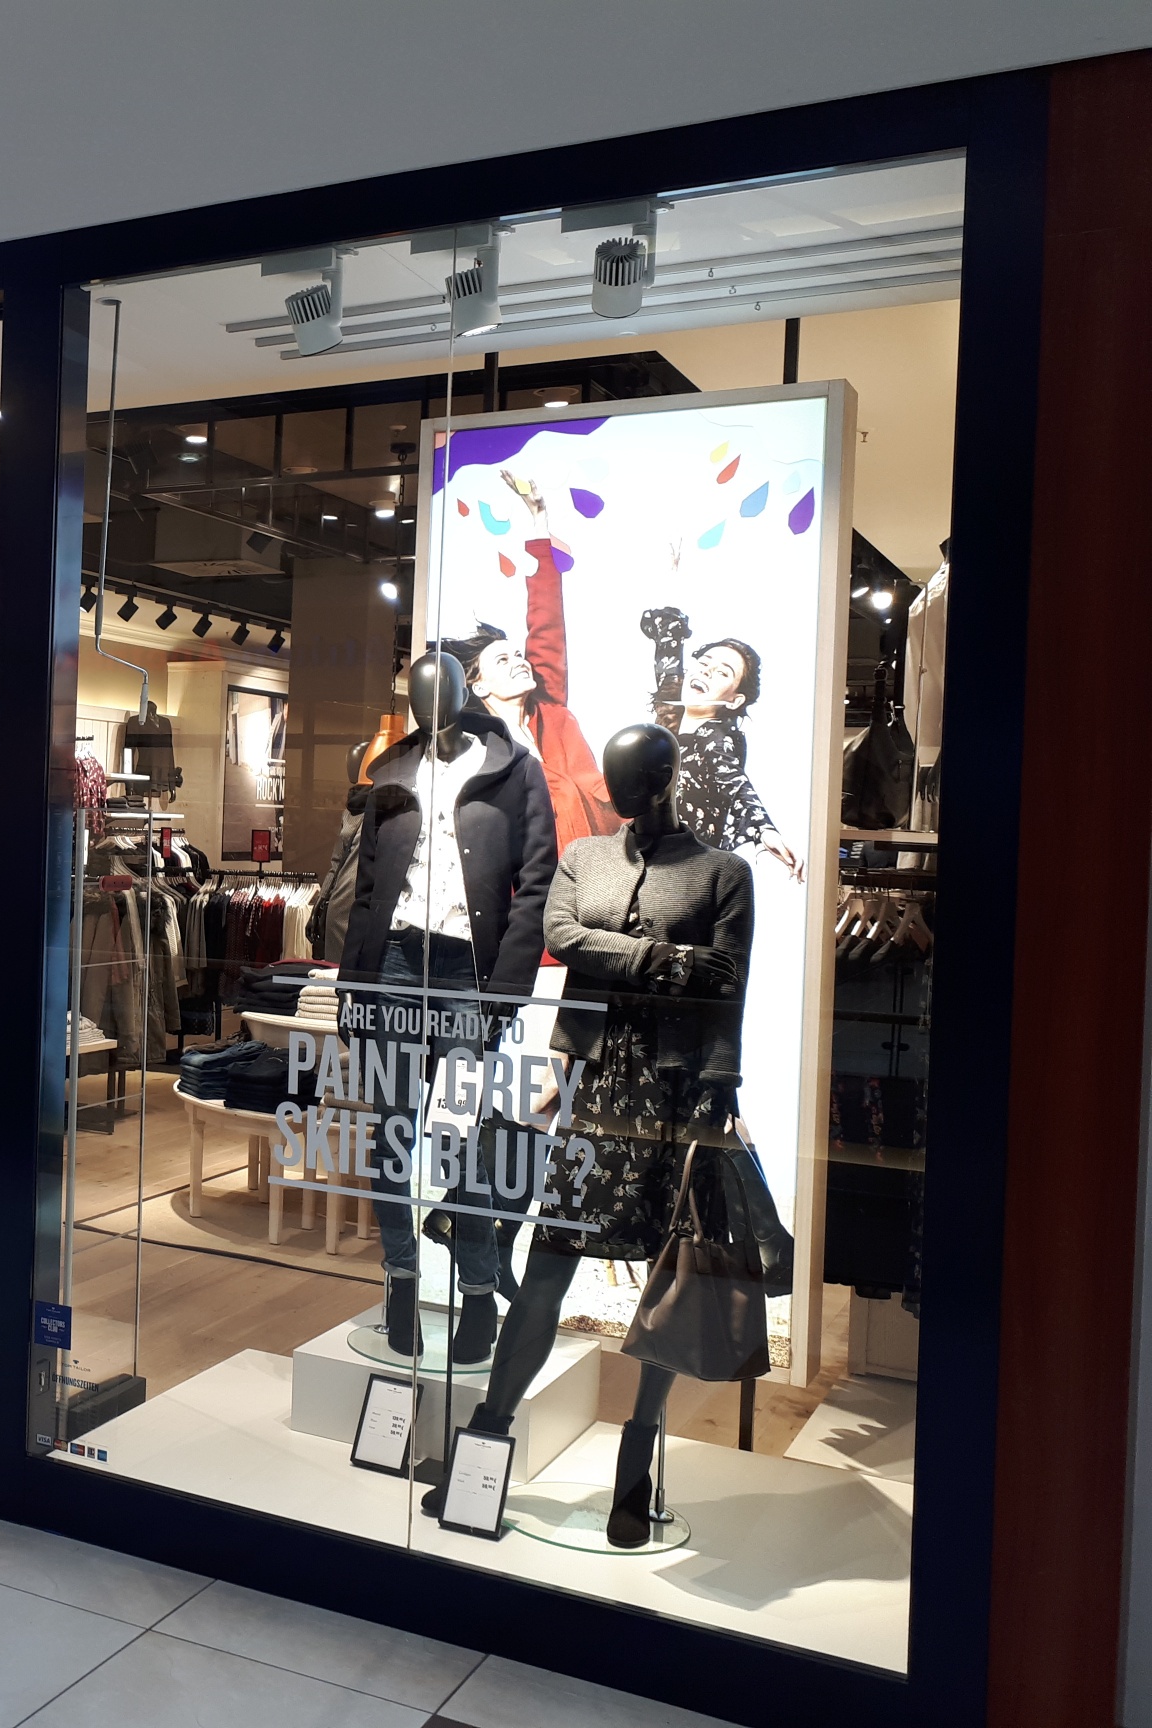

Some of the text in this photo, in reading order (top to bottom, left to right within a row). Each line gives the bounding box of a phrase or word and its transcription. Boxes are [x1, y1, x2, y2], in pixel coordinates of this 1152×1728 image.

[339, 1003, 525, 1044] ARE YOU READY TO
[287, 1030, 587, 1128] PAINT GREY
[273, 1101, 596, 1208] SKIES BLUE?
[38, 1436, 51, 1446] VISA
